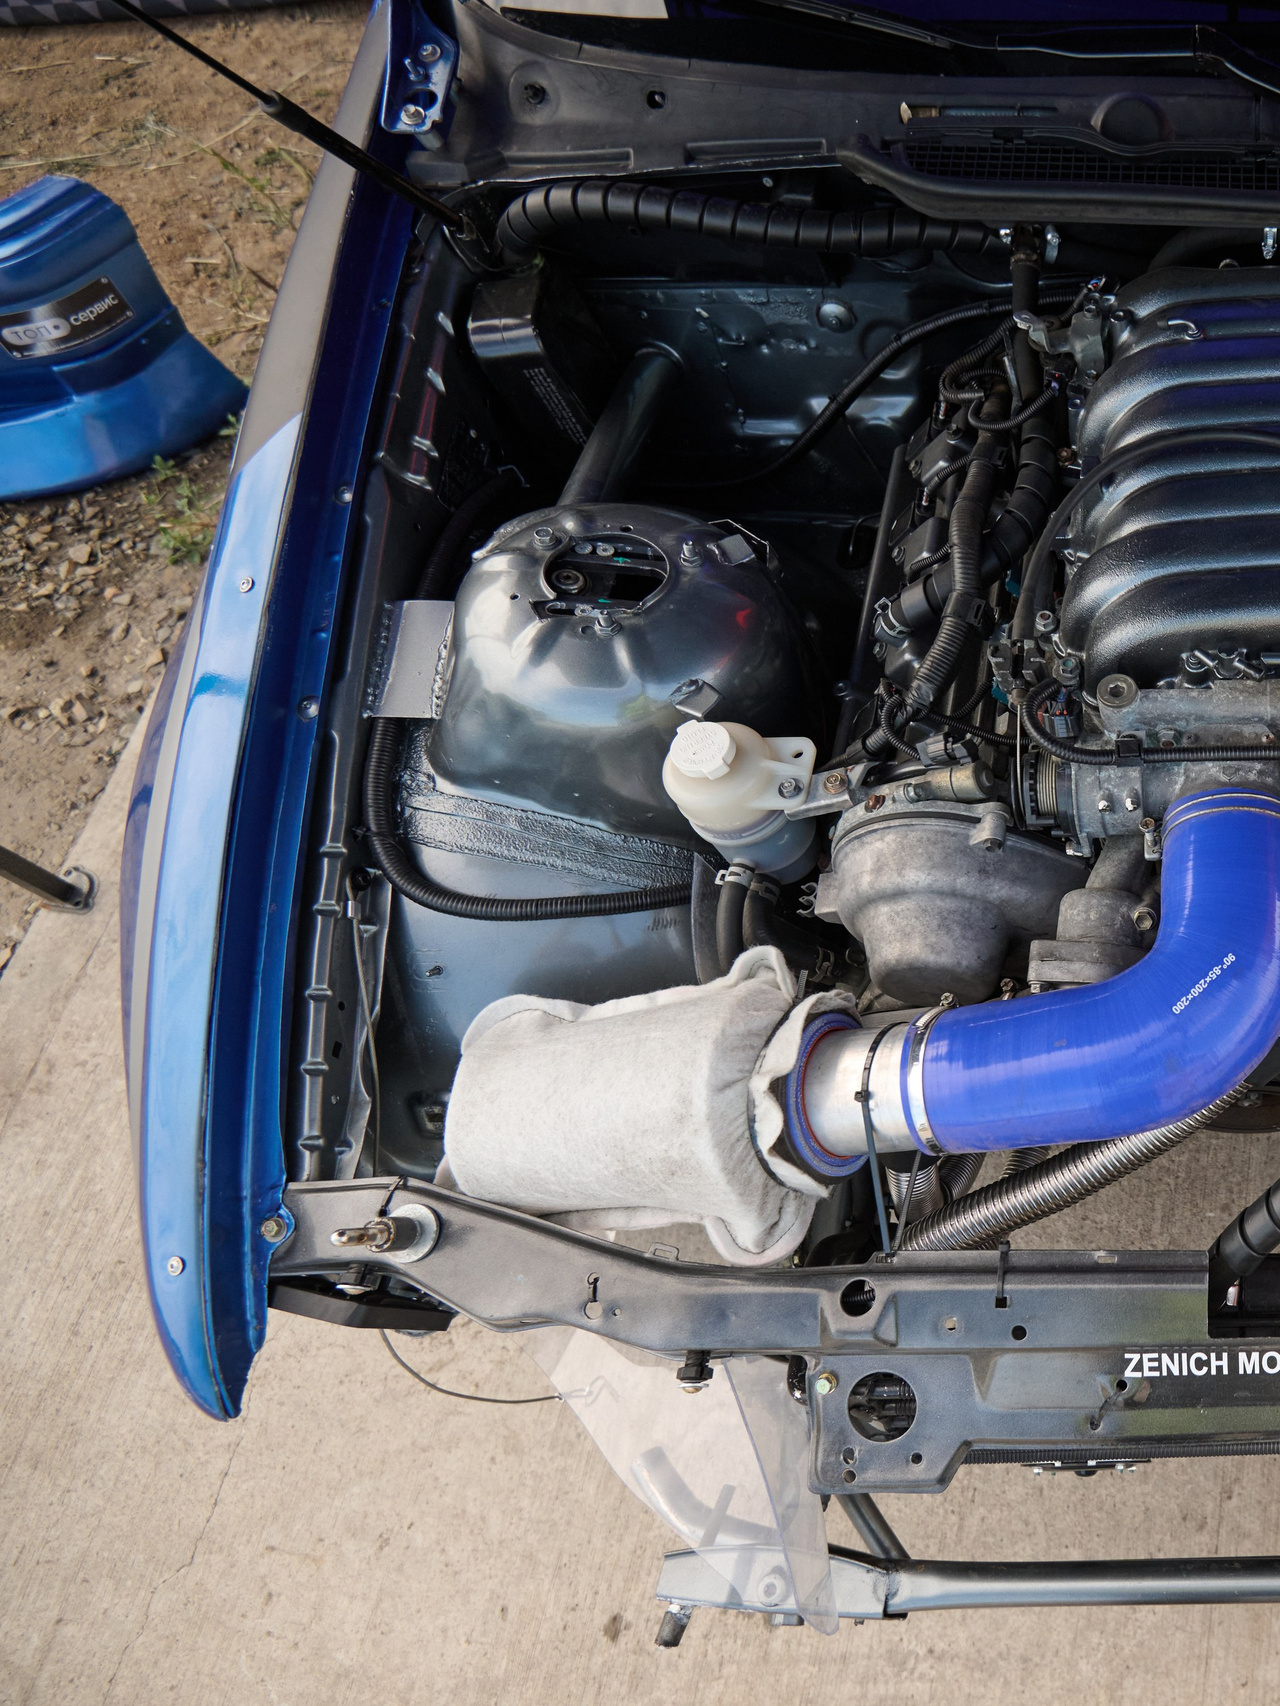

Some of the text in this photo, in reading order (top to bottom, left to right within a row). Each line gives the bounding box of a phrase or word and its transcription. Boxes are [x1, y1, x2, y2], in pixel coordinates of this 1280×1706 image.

[10, 325, 52, 341] ТОП
[70, 294, 119, 326] сервис
[1123, 1351, 1229, 1377] ZENICH
